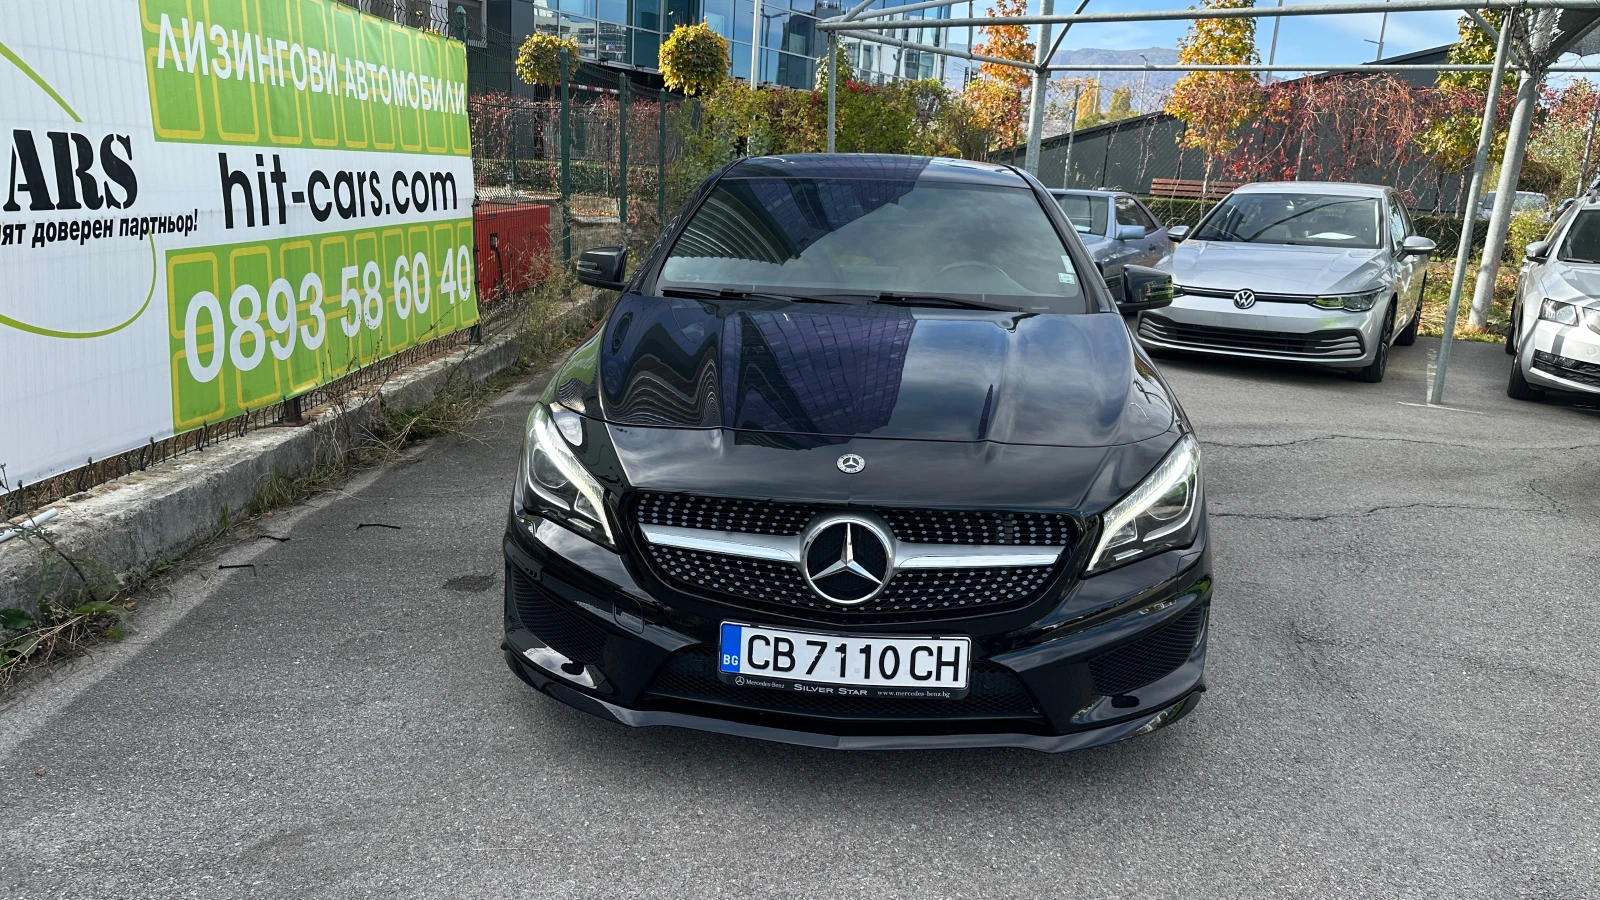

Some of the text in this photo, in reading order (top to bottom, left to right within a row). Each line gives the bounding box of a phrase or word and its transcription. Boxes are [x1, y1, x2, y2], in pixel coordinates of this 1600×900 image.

[157, 13, 466, 116] ЛИЗИНГОВИ АВТОМОБИЛИ
[218, 153, 458, 230] hit-cars.com
[0, 208, 198, 248] ят доверен партньор!
[184, 244, 471, 383] 0893 58 60 40
[723, 654, 739, 666] BG
[747, 634, 960, 682] CB 7110 CH
[745, 679, 785, 689] Mercedes-Benz
[877, 690, 951, 698] www.mercedes-benz.bg
